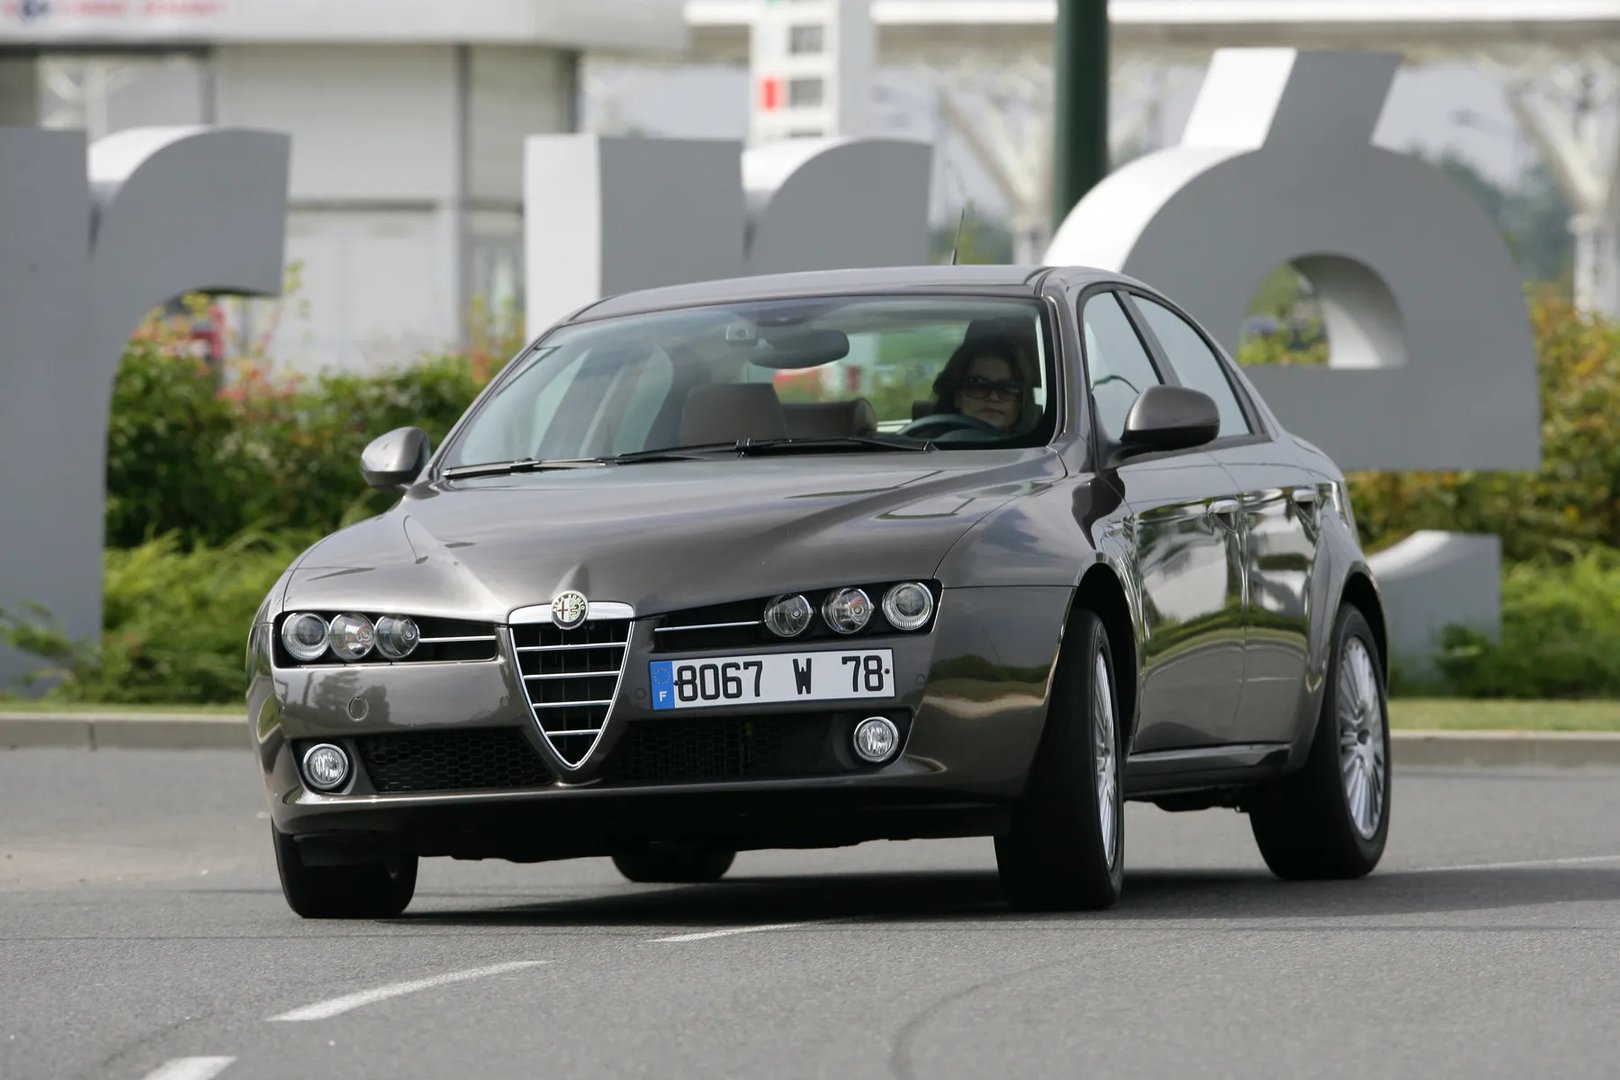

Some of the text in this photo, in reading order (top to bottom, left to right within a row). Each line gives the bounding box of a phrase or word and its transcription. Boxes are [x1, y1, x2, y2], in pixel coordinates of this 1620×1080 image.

[677, 655, 884, 702] 8067 W 78
[659, 691, 668, 702] F
